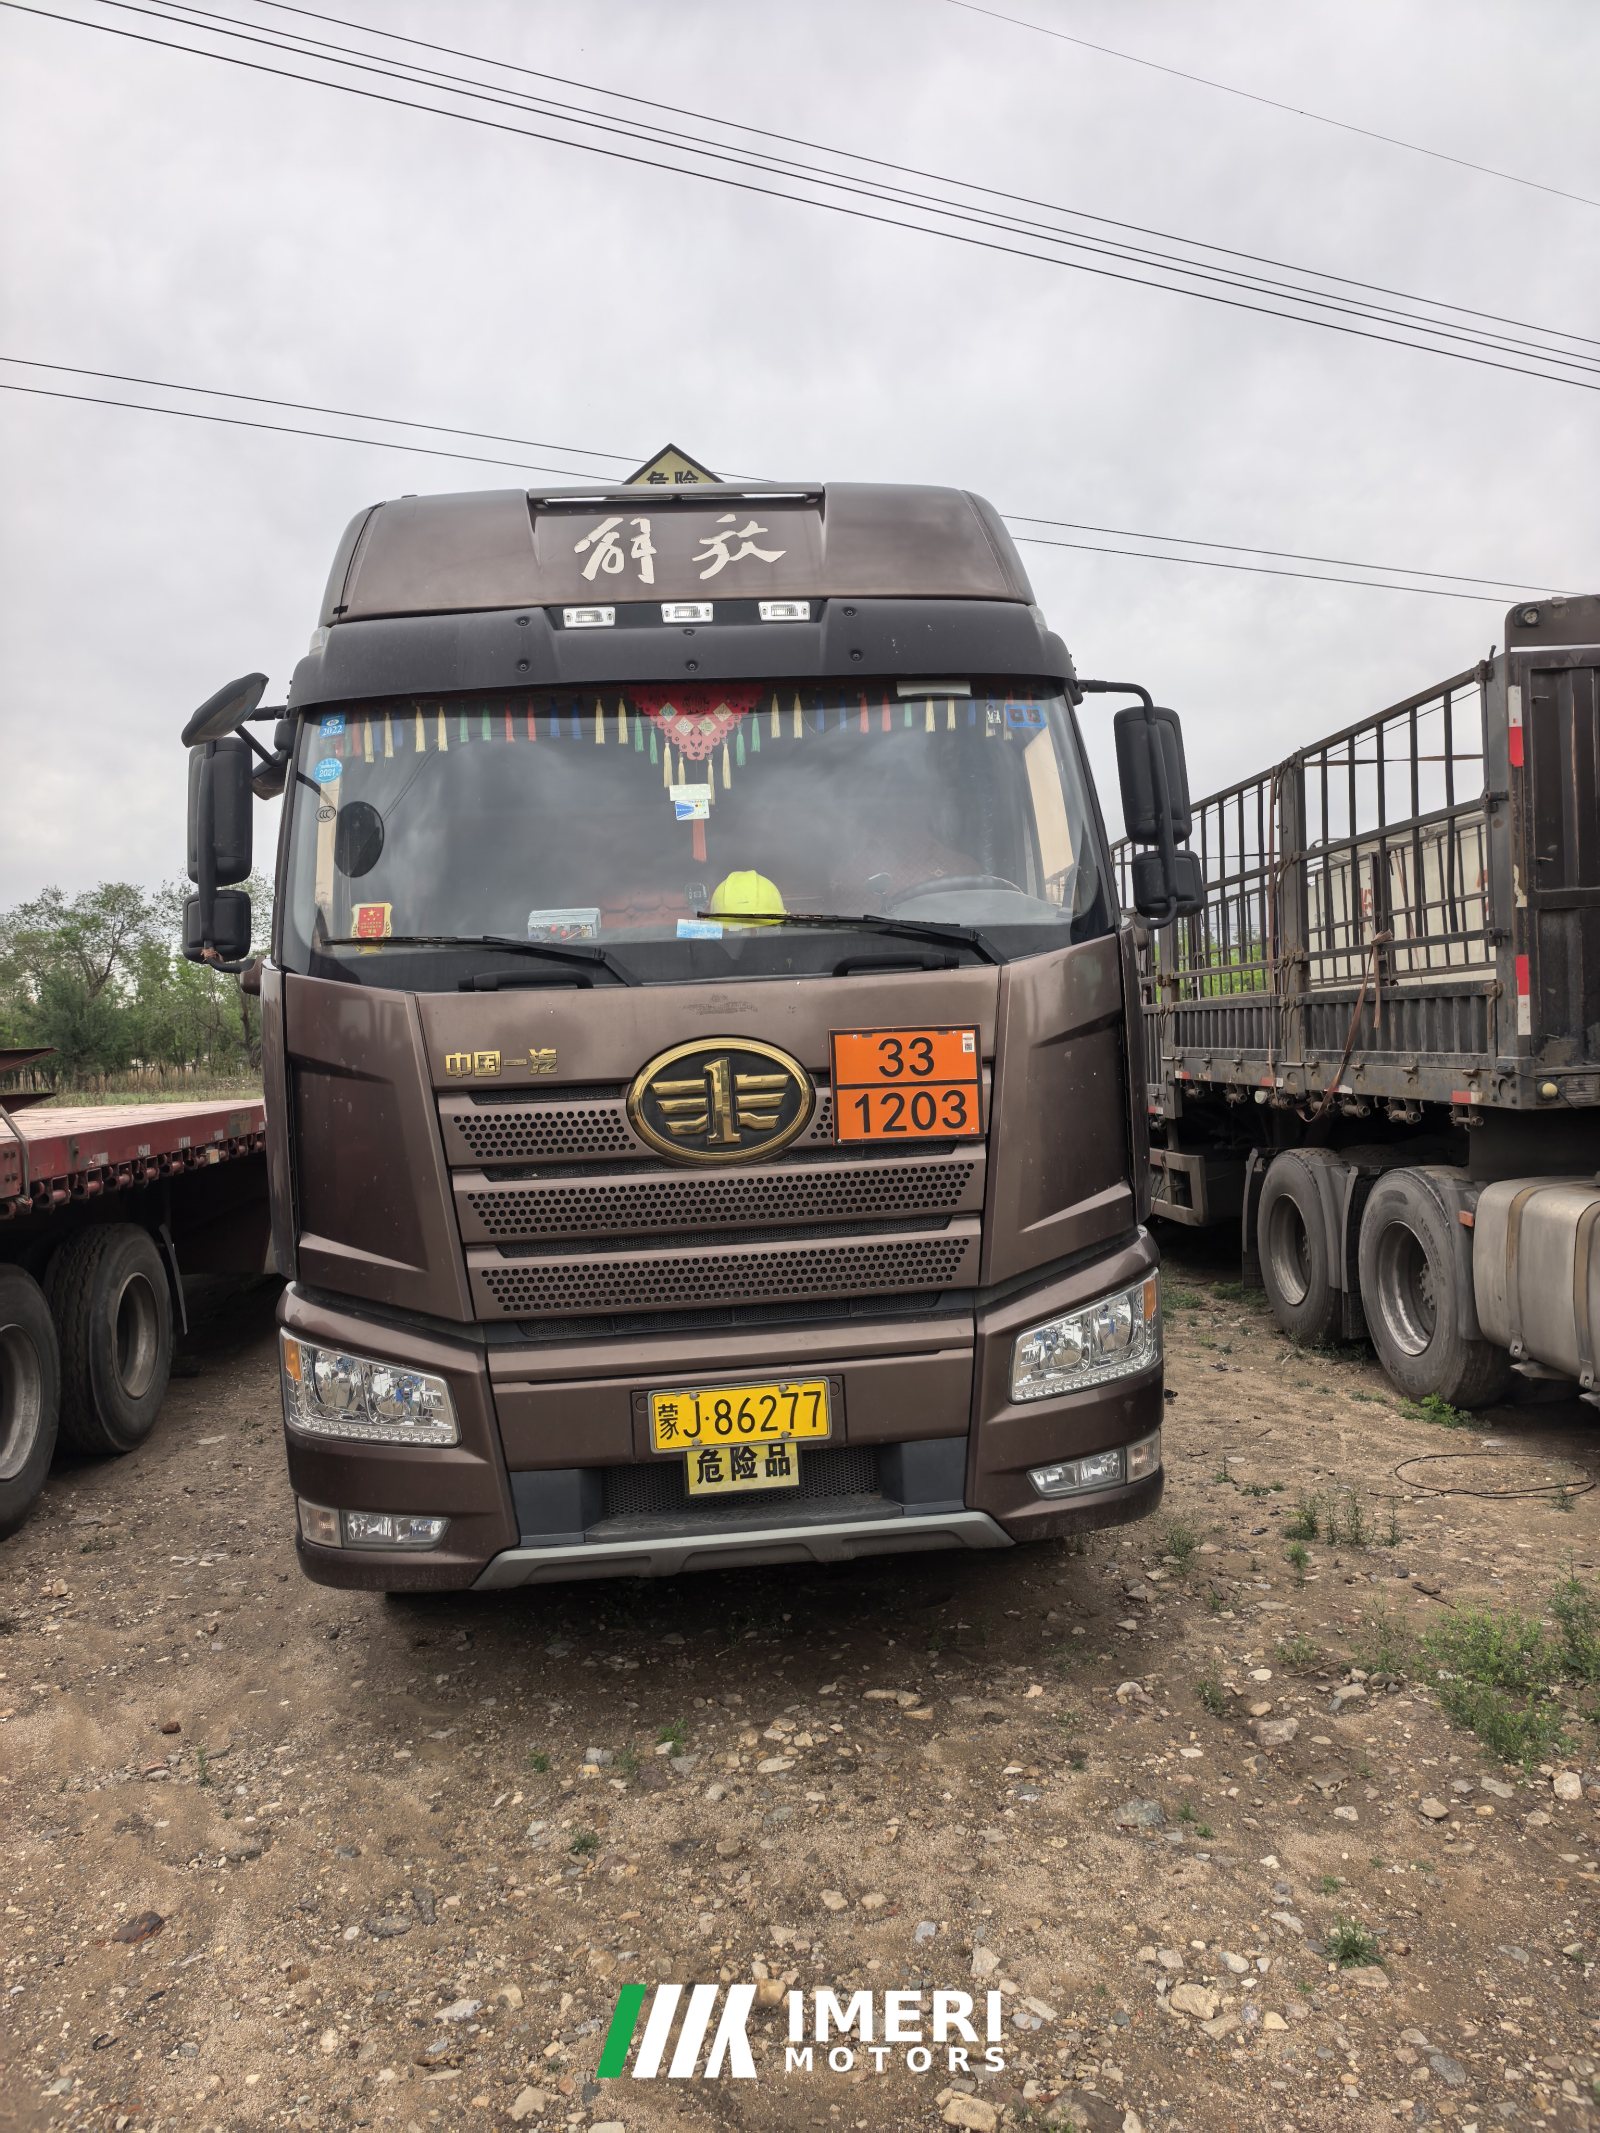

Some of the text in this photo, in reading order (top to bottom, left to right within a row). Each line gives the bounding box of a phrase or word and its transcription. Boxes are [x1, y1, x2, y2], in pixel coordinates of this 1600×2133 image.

[573, 513, 788, 584] 解放
[322, 725, 344, 736] 2022
[445, 1049, 558, 1078] 中国一汽
[878, 1037, 935, 1078] 33
[854, 1089, 968, 1133] 1203
[697, 1442, 791, 1484] 危险品
